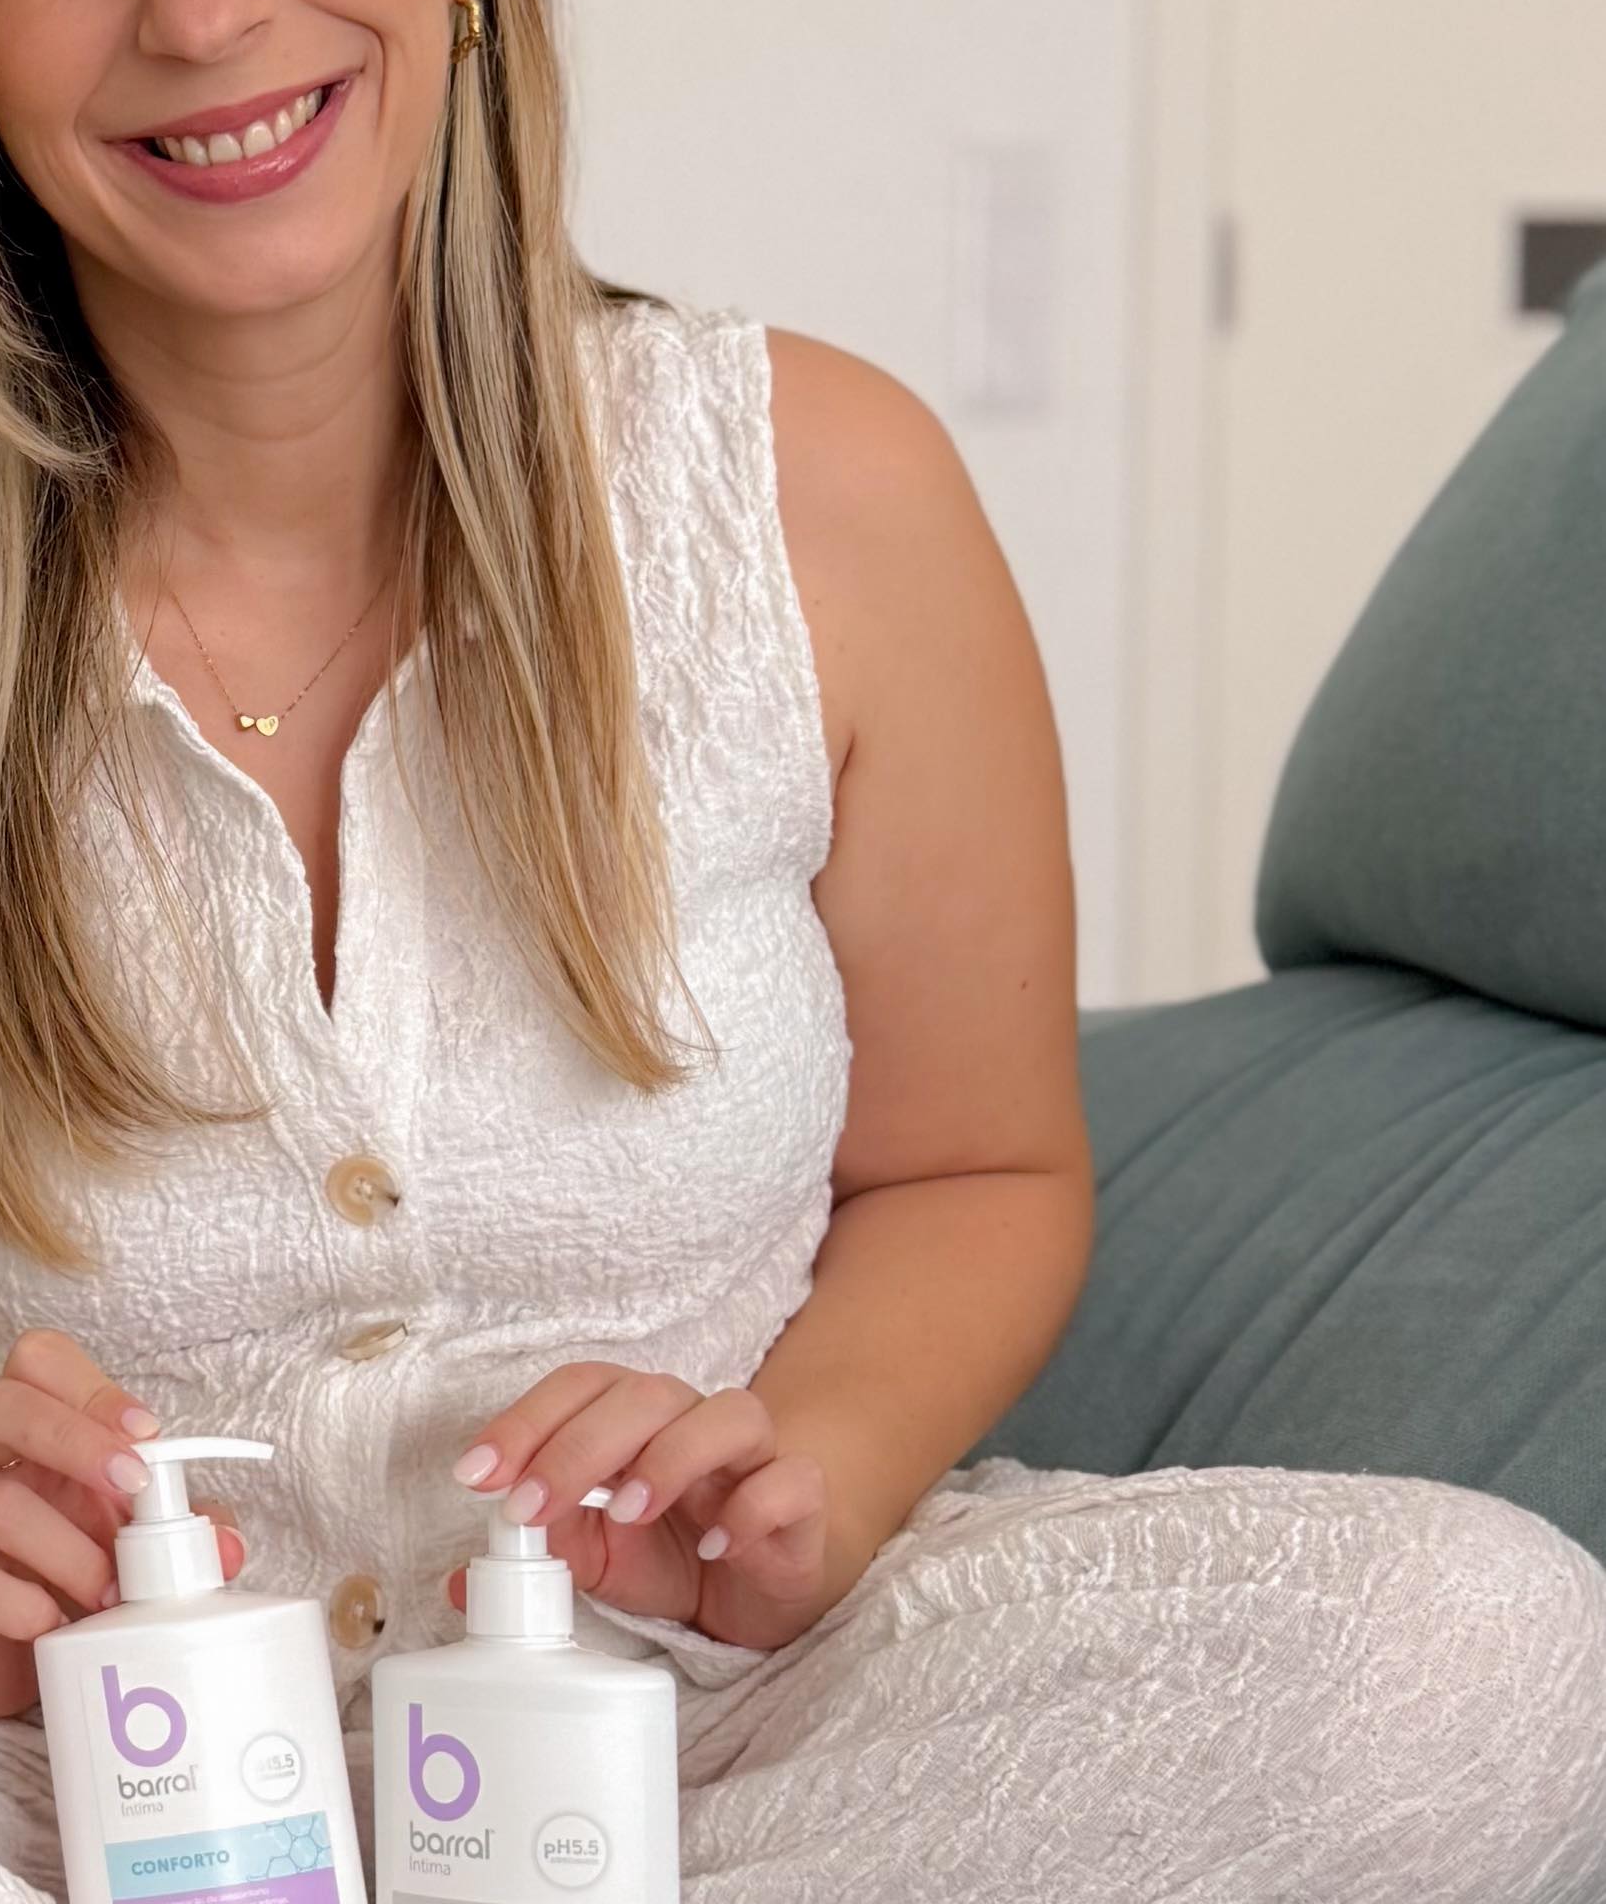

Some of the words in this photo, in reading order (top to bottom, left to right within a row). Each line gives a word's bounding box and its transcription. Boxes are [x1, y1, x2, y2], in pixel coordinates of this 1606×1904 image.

[101, 1665, 187, 1767] b
[409, 1703, 481, 1821] b
[117, 1764, 197, 1800] barral
[409, 1820, 490, 1860] barral
[543, 1839, 600, 1859] pH5.5
[131, 1850, 230, 1876] CONFORTO
